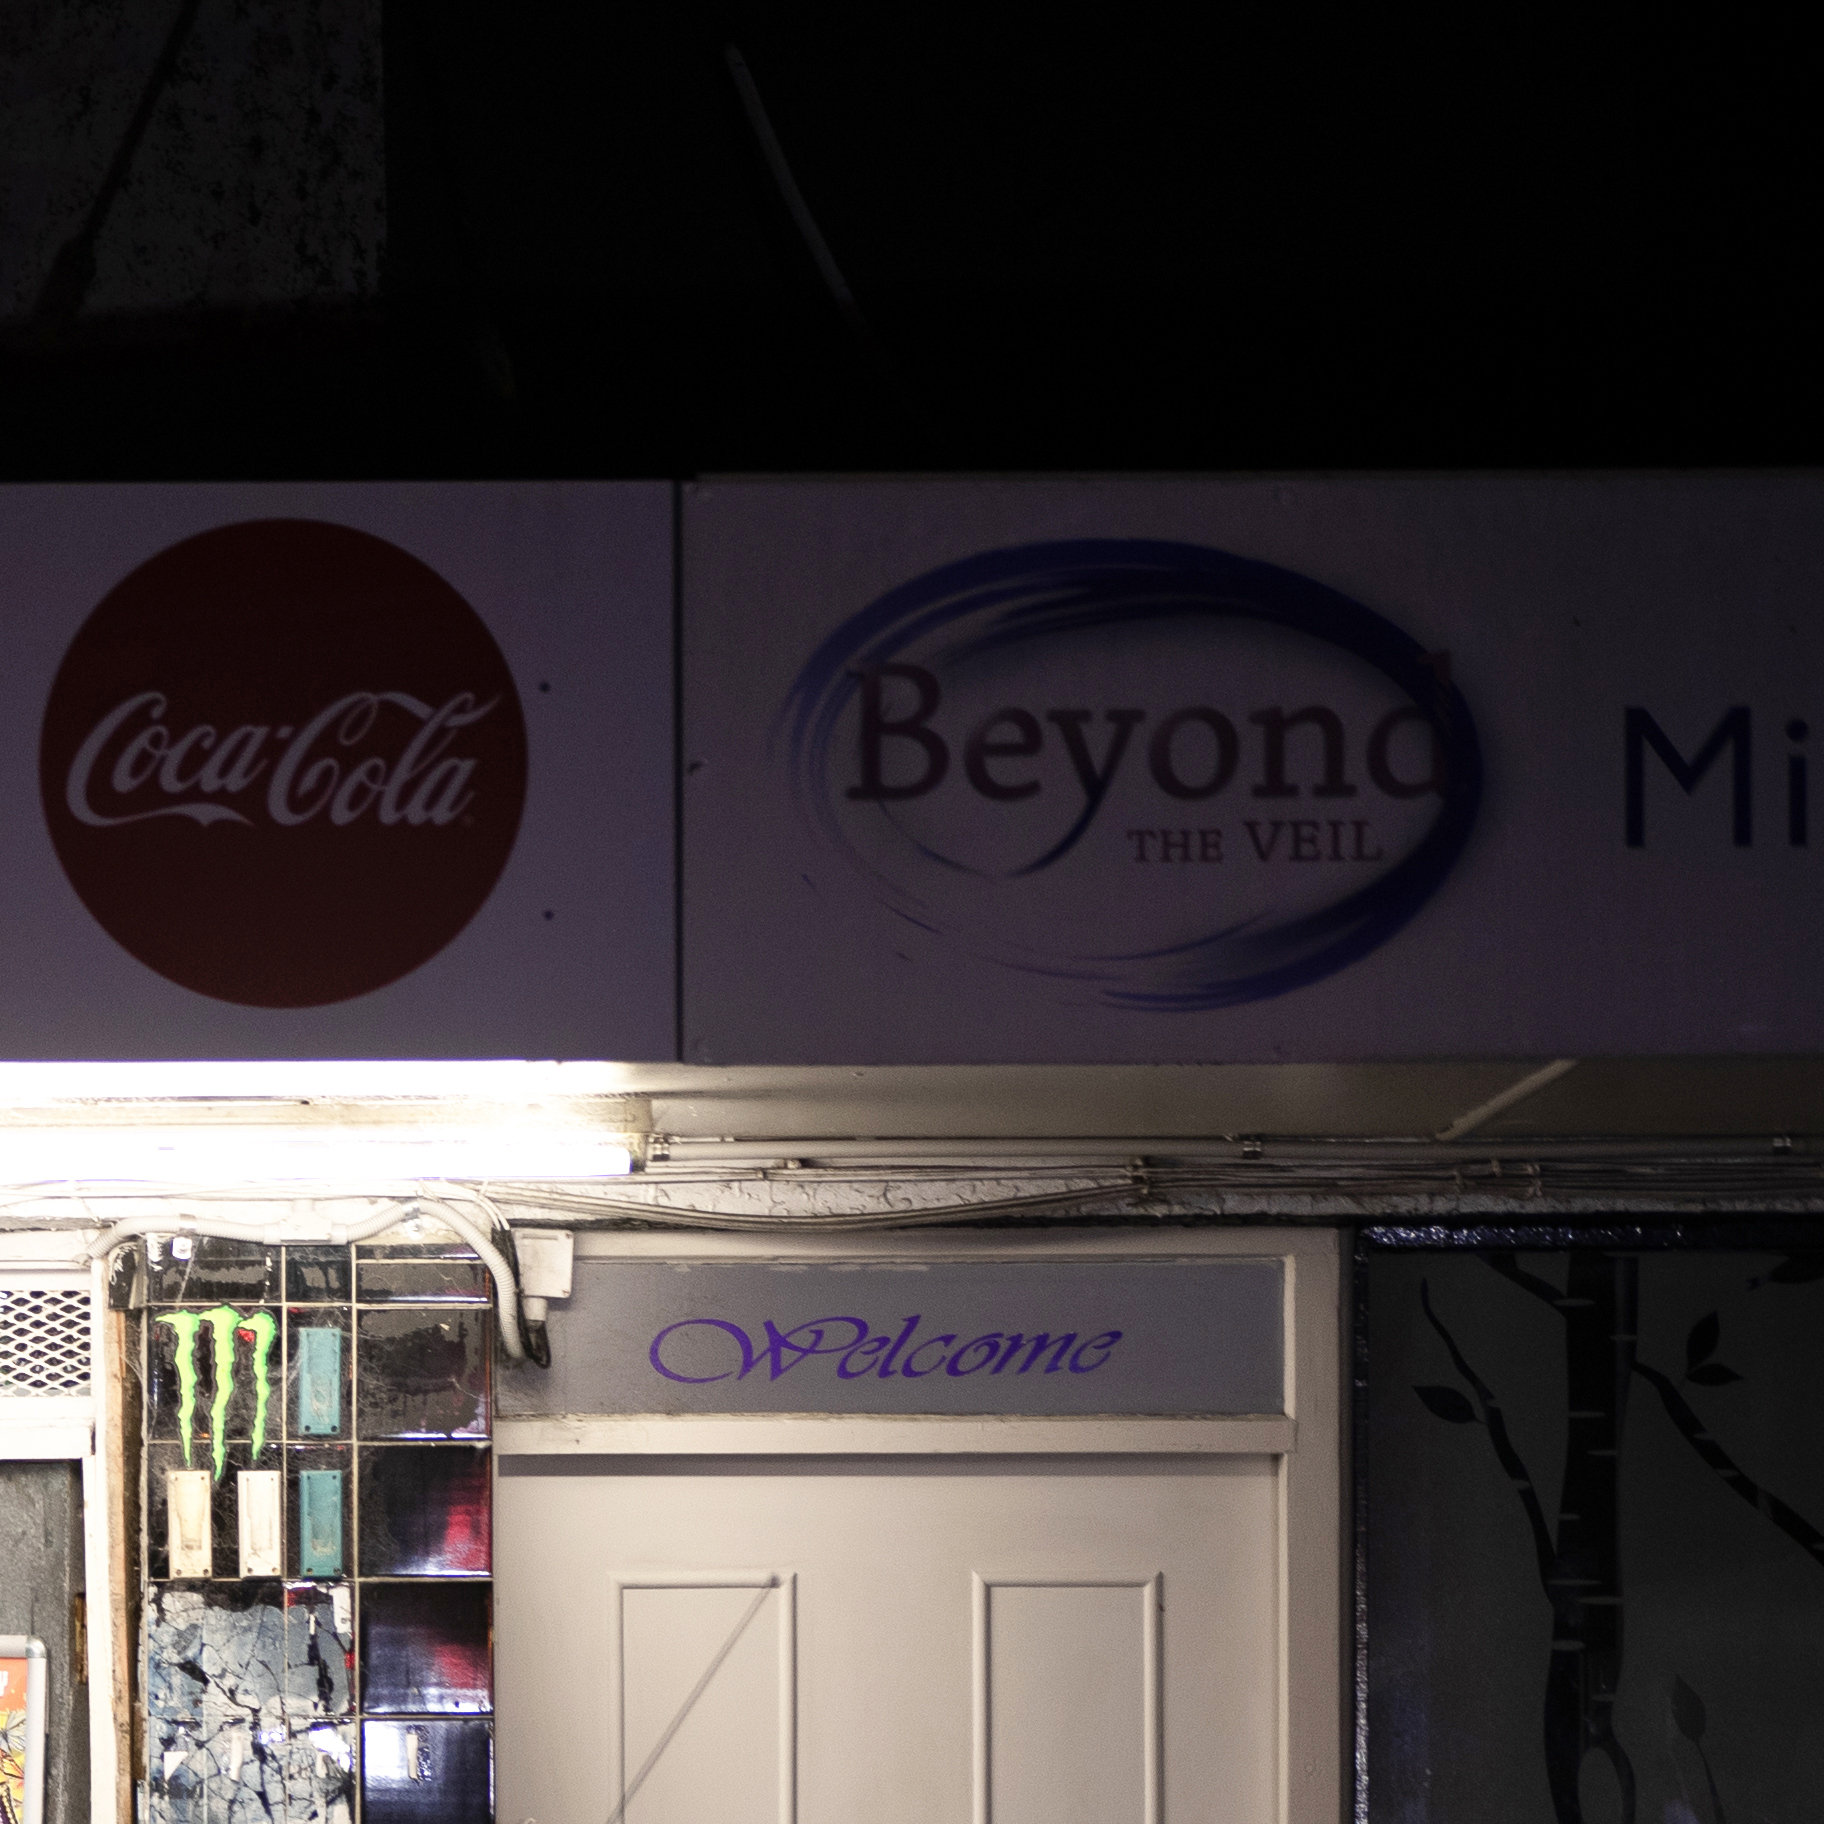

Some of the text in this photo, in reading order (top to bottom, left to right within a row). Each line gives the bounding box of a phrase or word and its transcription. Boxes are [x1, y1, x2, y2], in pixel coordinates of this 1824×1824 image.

[66, 690, 503, 828] Coca-Cola
[846, 650, 1454, 850] Beyond
[1625, 706, 1810, 847] Mi
[1127, 818, 1384, 865] THE VEIL
[649, 1314, 1124, 1385] Welcome
